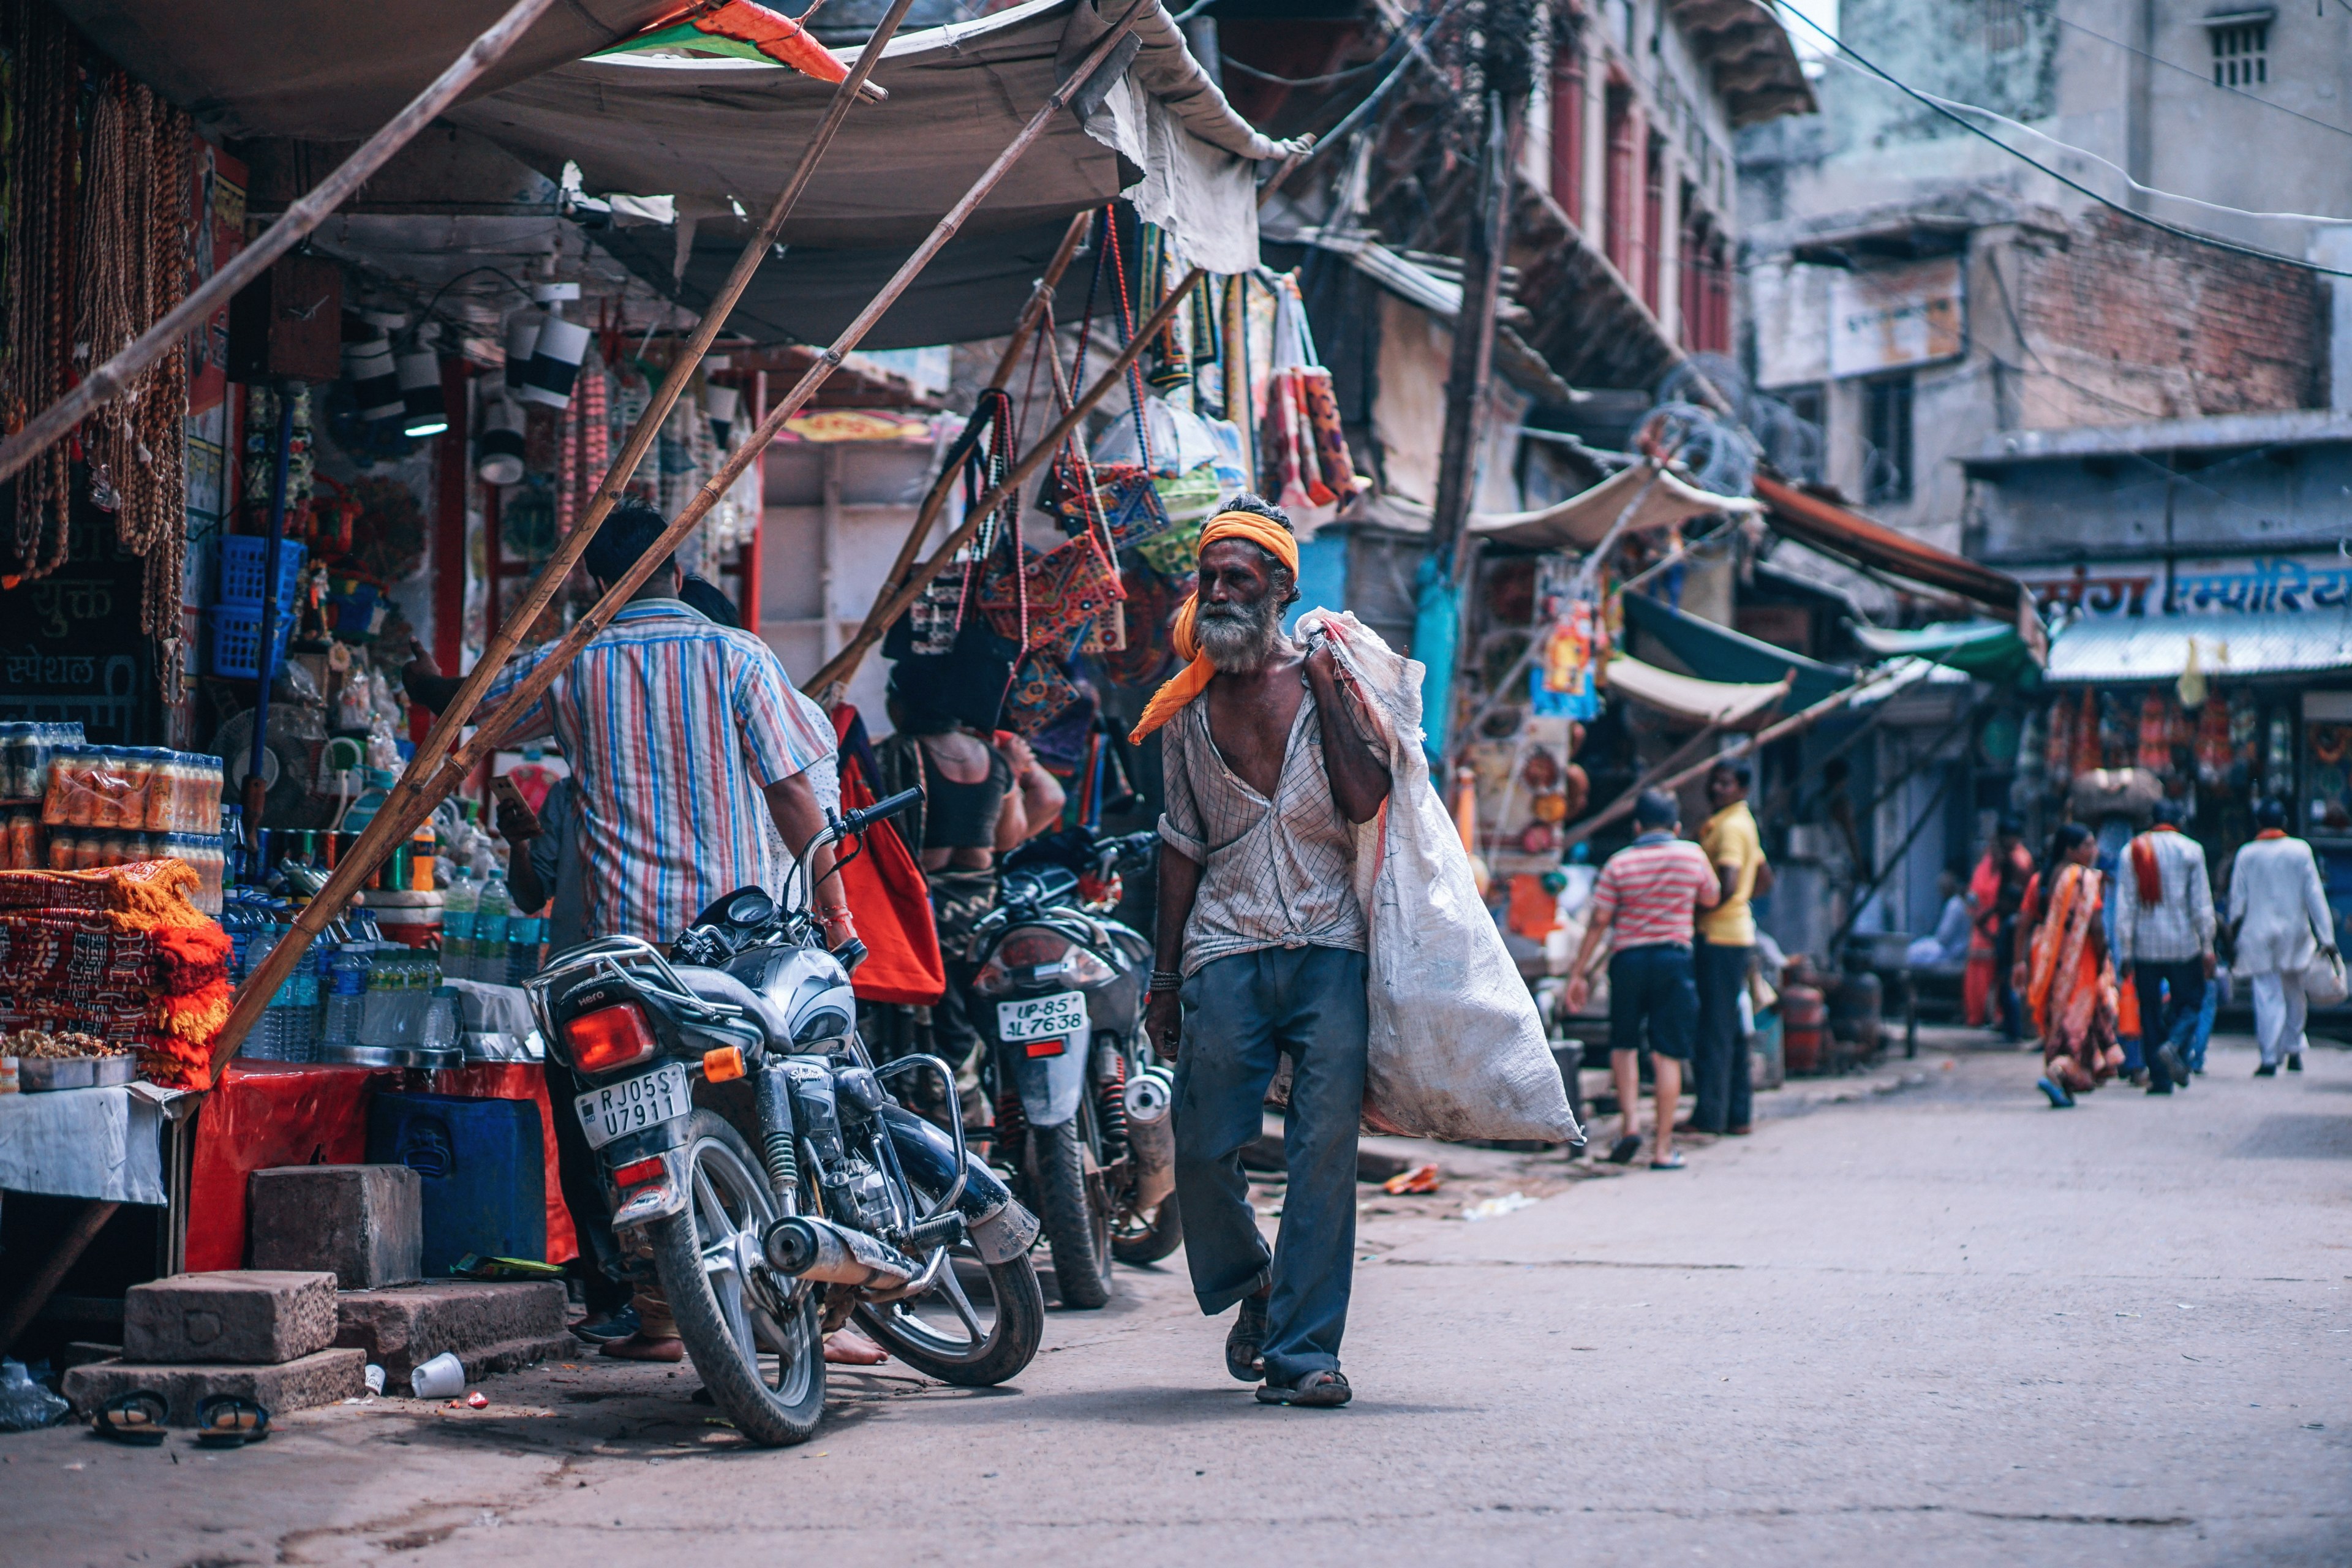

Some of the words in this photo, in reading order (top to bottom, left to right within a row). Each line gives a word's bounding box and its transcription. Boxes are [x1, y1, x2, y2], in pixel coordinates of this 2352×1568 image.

[600, 1071, 671, 1111] RJ05S
[584, 1115, 596, 1125] IND
[605, 1093, 674, 1136] U7911
